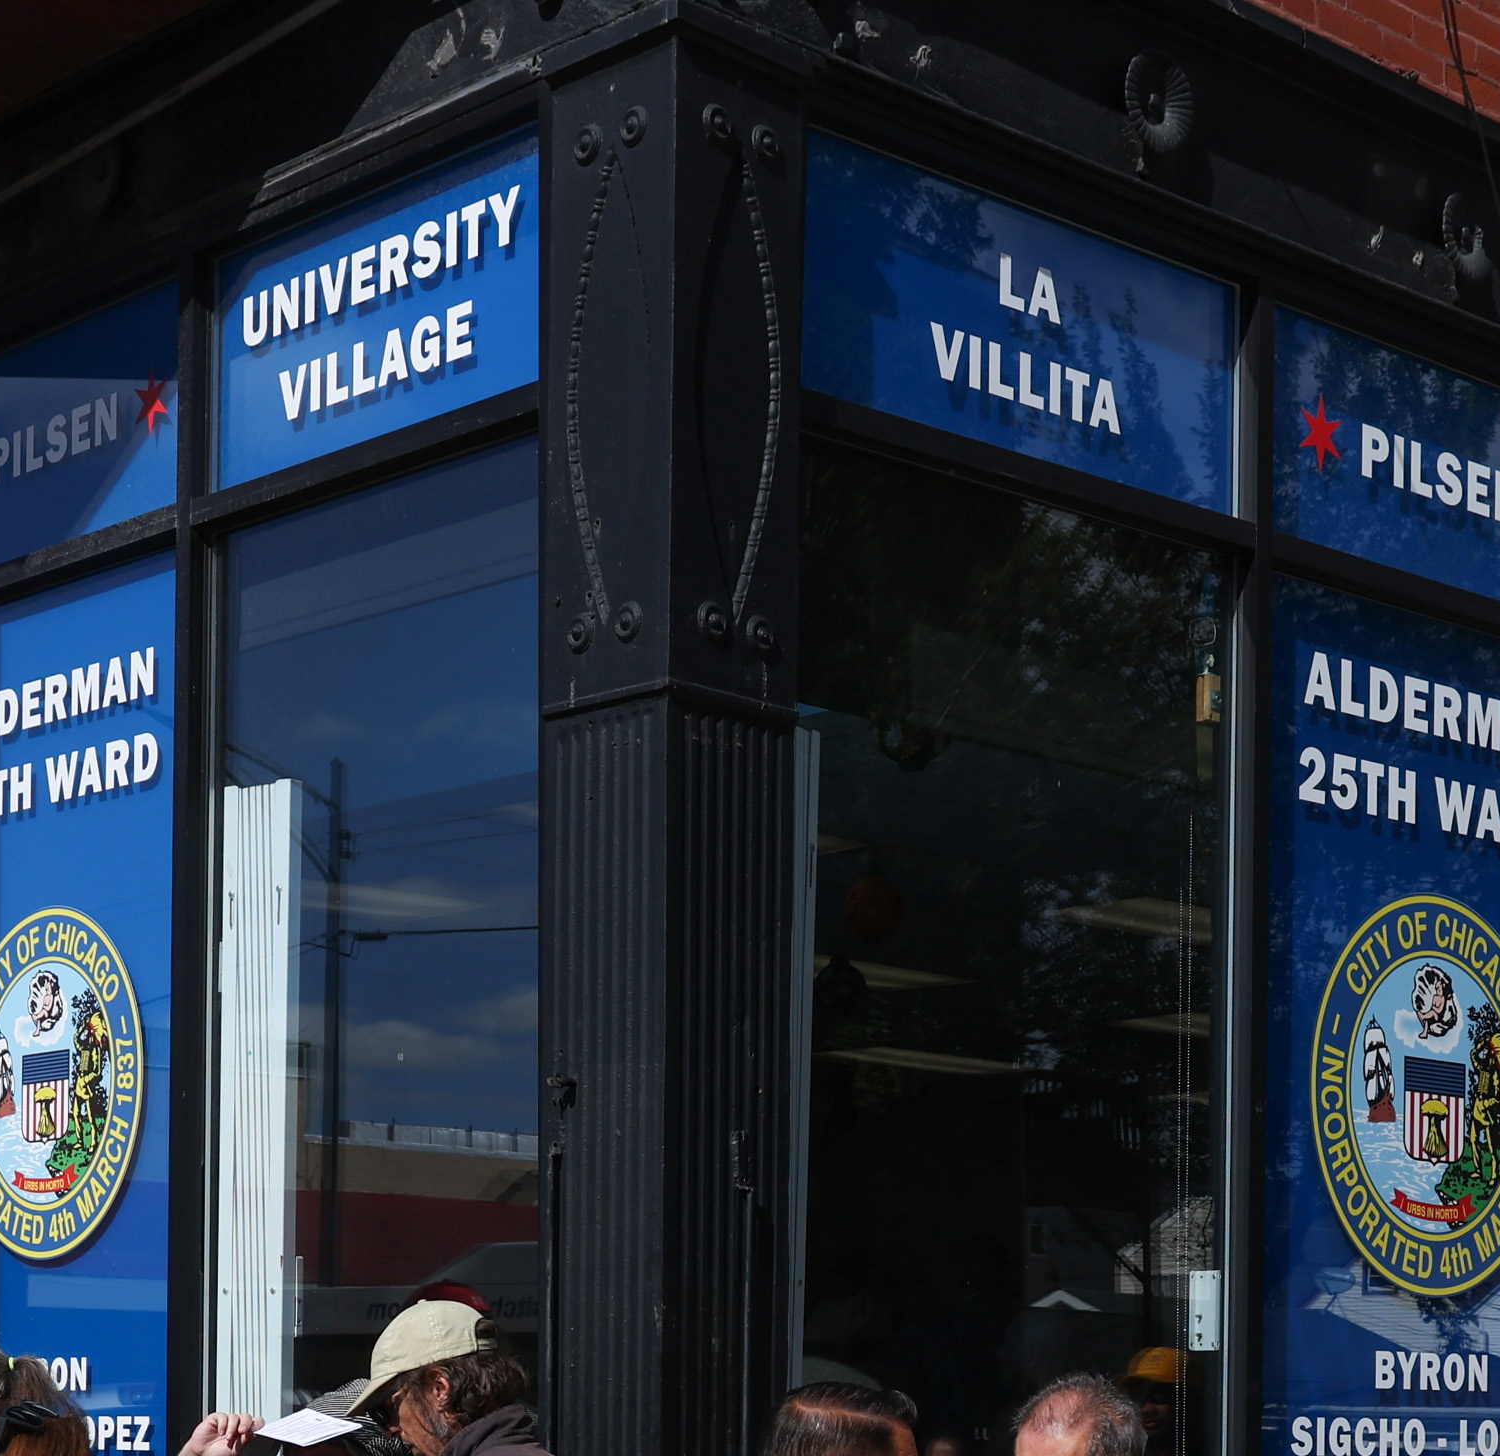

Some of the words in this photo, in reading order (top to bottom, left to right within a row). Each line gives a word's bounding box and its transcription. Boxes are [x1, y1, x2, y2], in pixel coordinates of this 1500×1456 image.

[242, 184, 520, 348] UNIVERSITY
[997, 252, 1060, 325] LA
[279, 300, 475, 421] VILLAGE
[930, 321, 1123, 437] VILLITA
[45, 732, 159, 804] WARD
[1297, 745, 1417, 826] 25TH
[16, 925, 41, 965] OF
[44, 922, 121, 1003] CHICAGO
[1346, 926, 1392, 996] CITY
[1398, 911, 1429, 951] OF
[48, 1210, 77, 1243] 4th
[75, 1117, 129, 1225] MARCH
[115, 1038, 135, 1112] 1837
[1320, 1043, 1434, 1280] INCORPORATED
[1439, 1246, 1473, 1279] 4th
[23, 1178, 38, 1191] URBS
[45, 1178, 65, 1191] HORTO
[1406, 1202, 1427, 1218] URBS
[1427, 1206, 1435, 1219] IN
[1435, 1206, 1459, 1221] HORTO
[1375, 1350, 1489, 1393] BYRON
